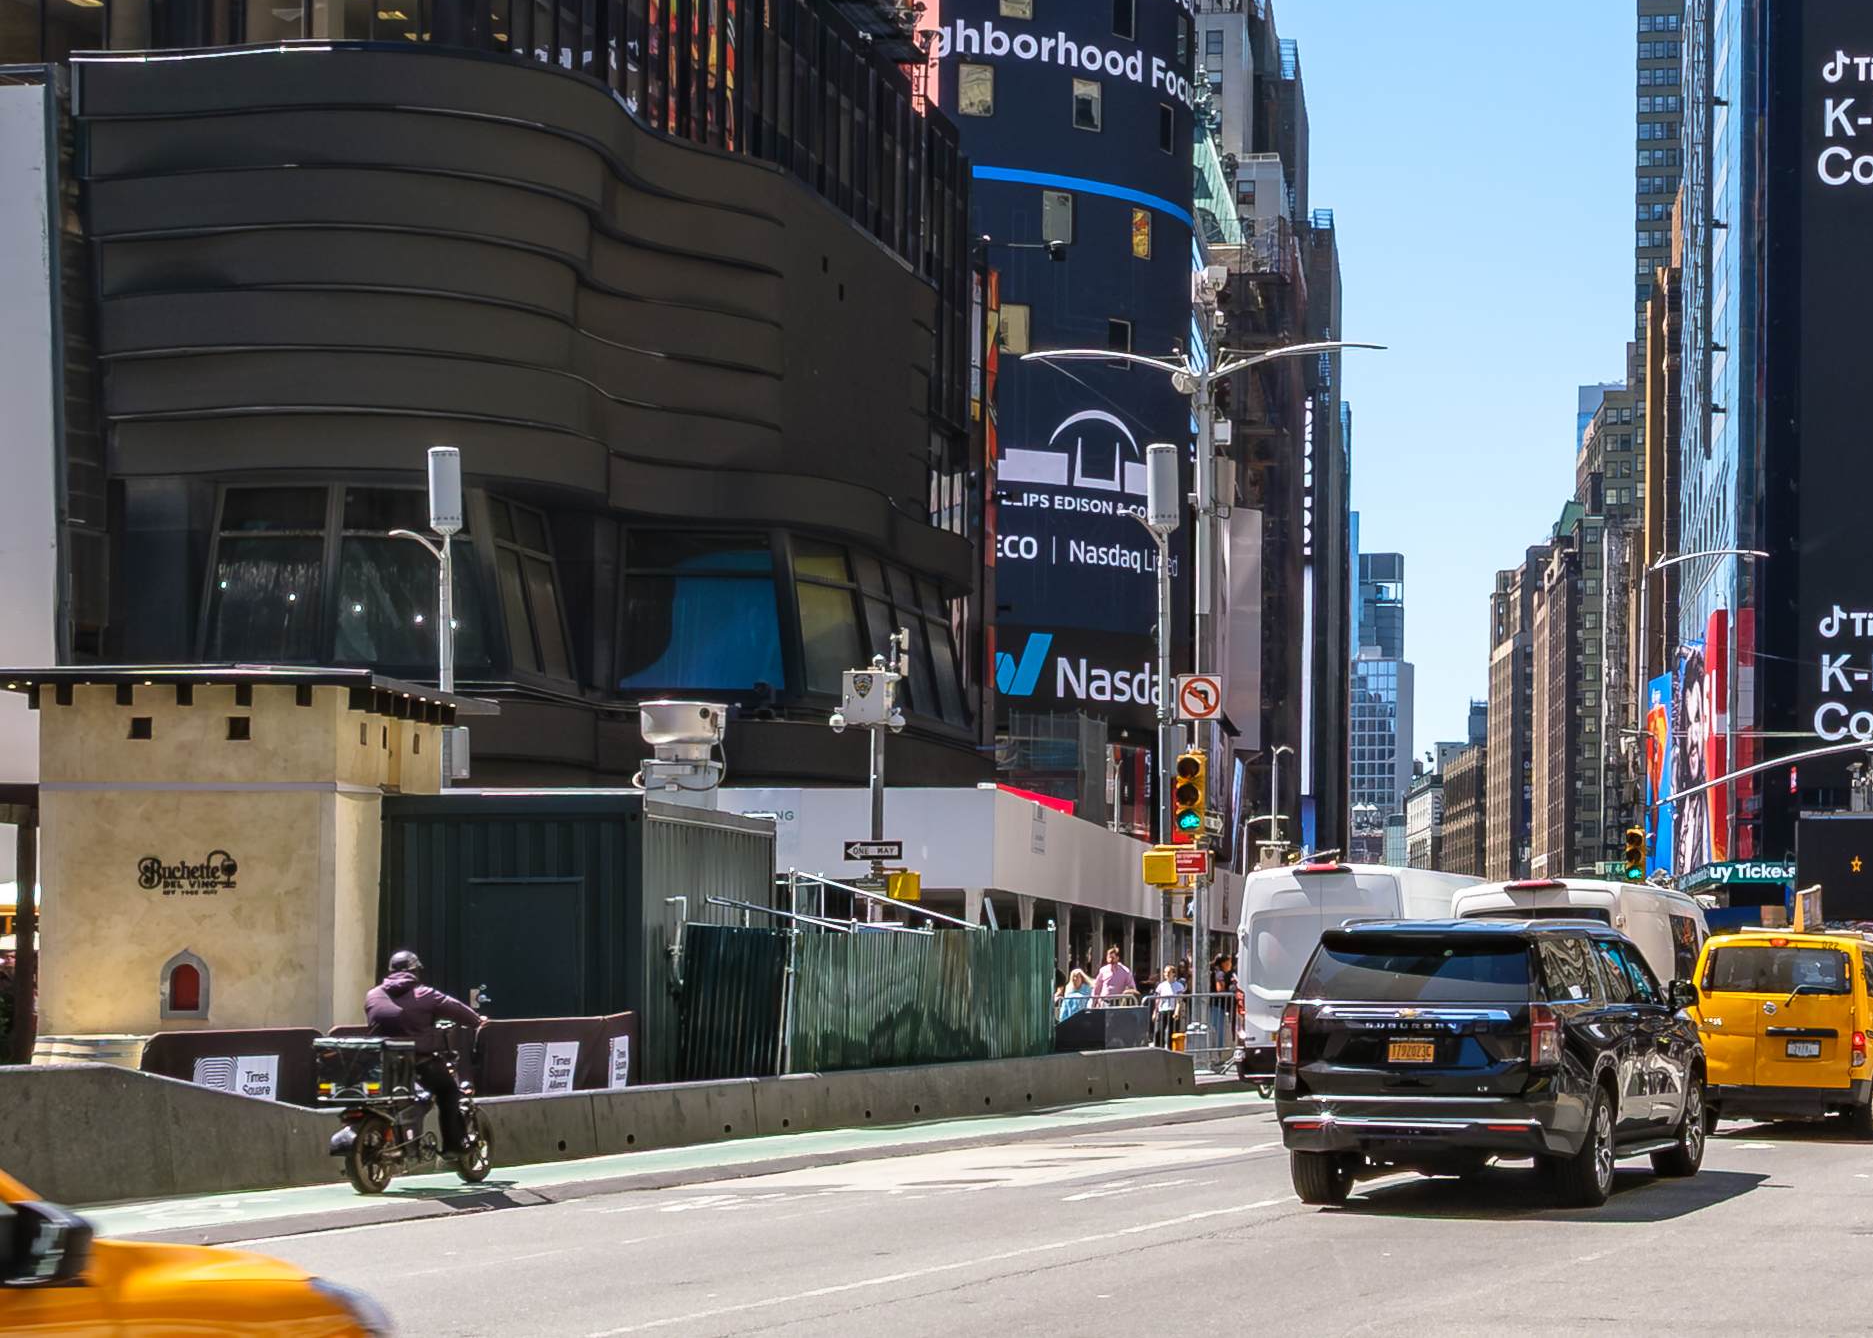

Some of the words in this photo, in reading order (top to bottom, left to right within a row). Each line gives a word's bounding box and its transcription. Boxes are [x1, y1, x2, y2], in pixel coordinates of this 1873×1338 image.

[938, 18, 1143, 83] ghborhood
[1151, 56, 1196, 111] Focu
[1054, 495, 1114, 515] EDISON
[1069, 539, 1141, 574] Nasdaq
[853, 846, 870, 856] ONE
[876, 846, 895, 856] WAY
[1709, 865, 1733, 884] uy
[245, 1070, 270, 1083] Times
